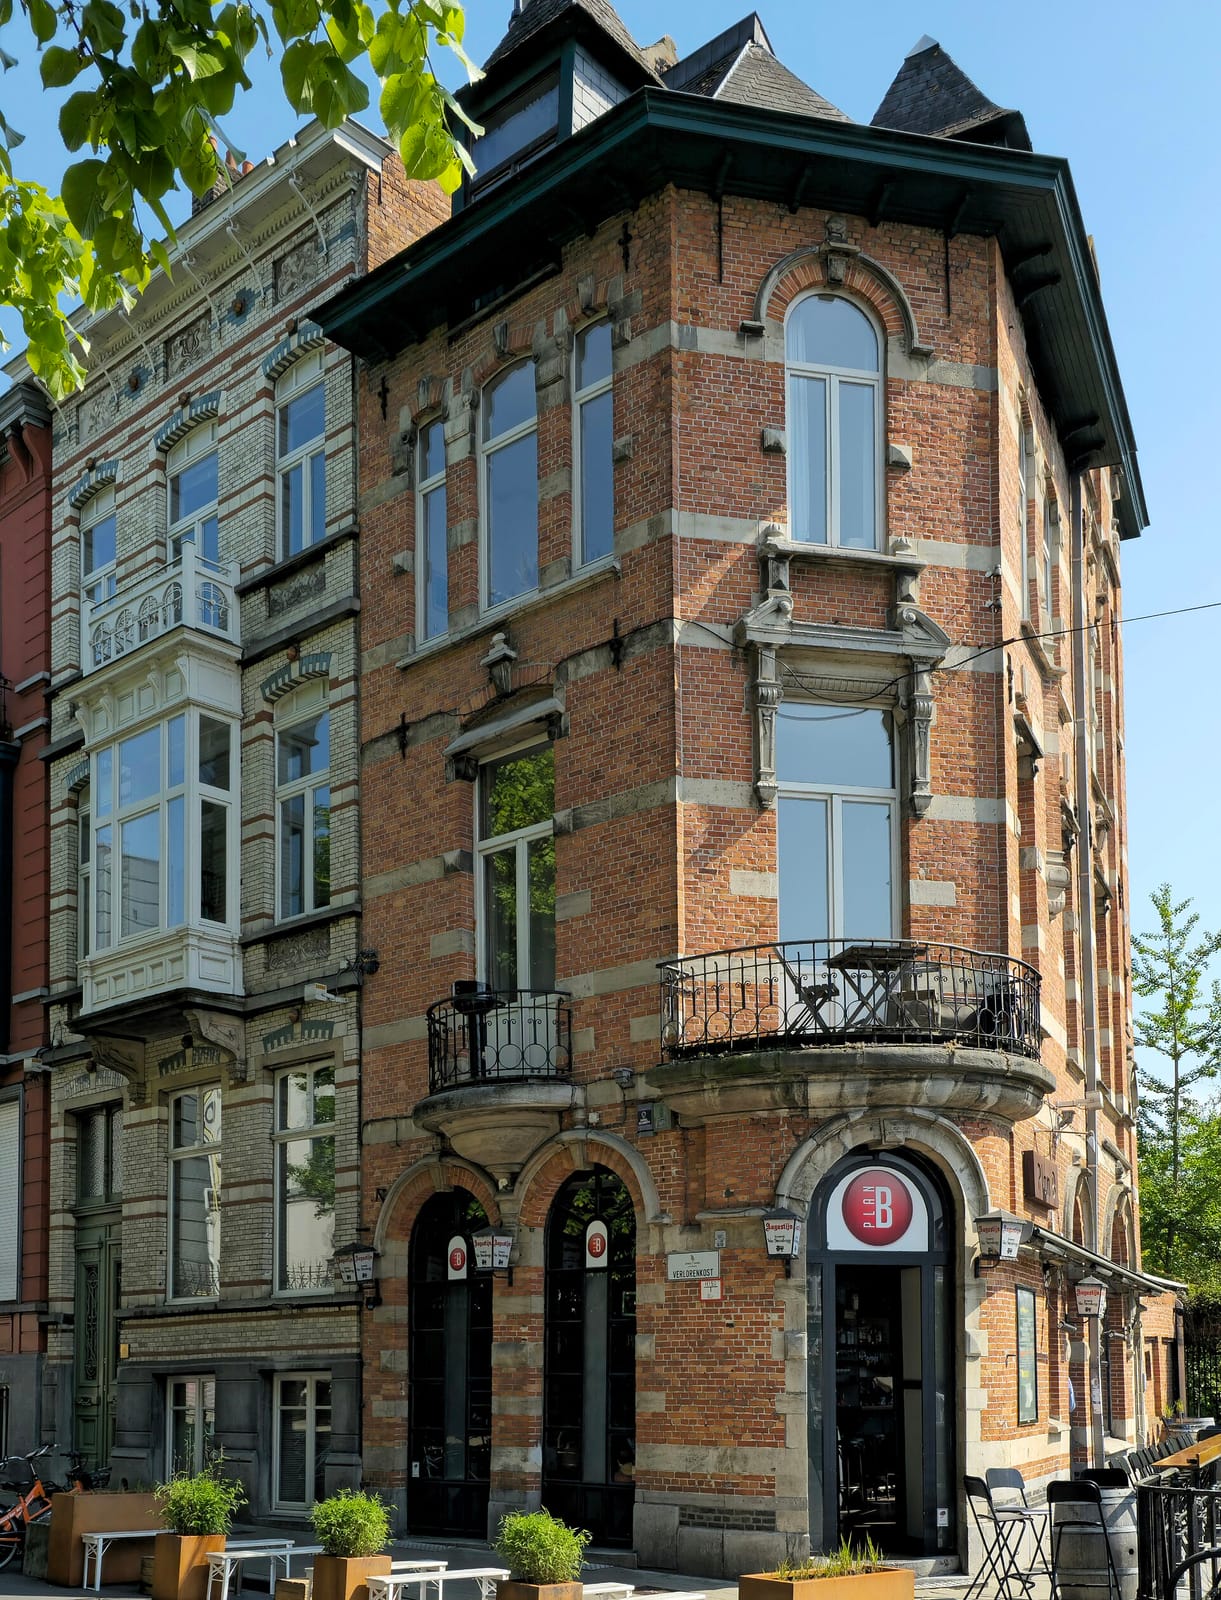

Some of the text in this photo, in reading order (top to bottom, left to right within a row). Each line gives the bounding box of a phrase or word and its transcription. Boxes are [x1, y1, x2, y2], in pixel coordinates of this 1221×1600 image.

[862, 1186, 893, 1228] PLAN B
[672, 1268, 713, 1278] VERLORENKOST
